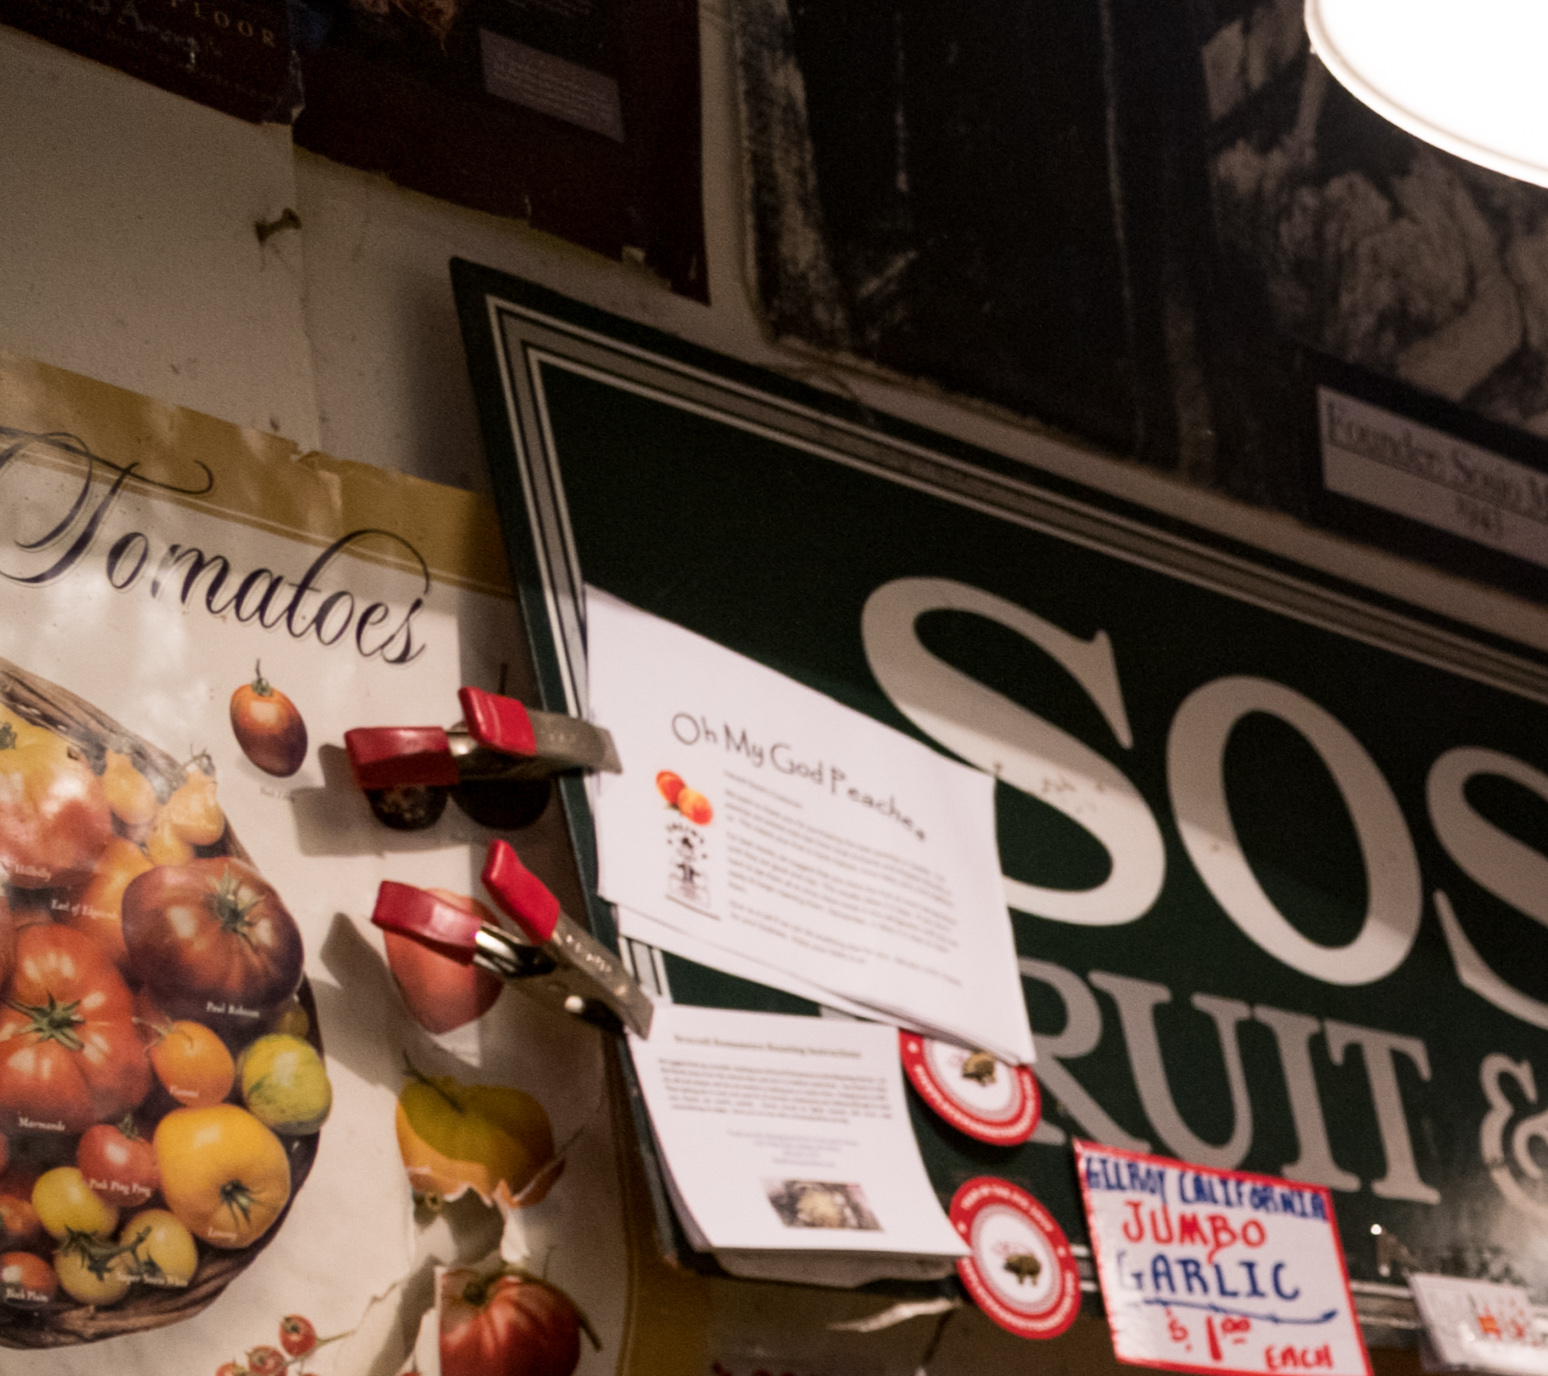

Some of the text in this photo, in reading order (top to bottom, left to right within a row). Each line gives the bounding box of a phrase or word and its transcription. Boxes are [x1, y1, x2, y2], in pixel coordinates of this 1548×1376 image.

[0, 426, 431, 664] Tomatoes
[672, 713, 717, 746] Oh
[724, 723, 764, 767] My
[770, 743, 823, 785] God
[1017, 958, 1441, 1204] RUIT
[1086, 1156, 1329, 1222] GILROY CALIFORNIA
[1122, 1200, 1267, 1252] JUMBO
[1116, 1250, 1301, 1301] GARLIC
[1264, 1344, 1335, 1373] EACH
